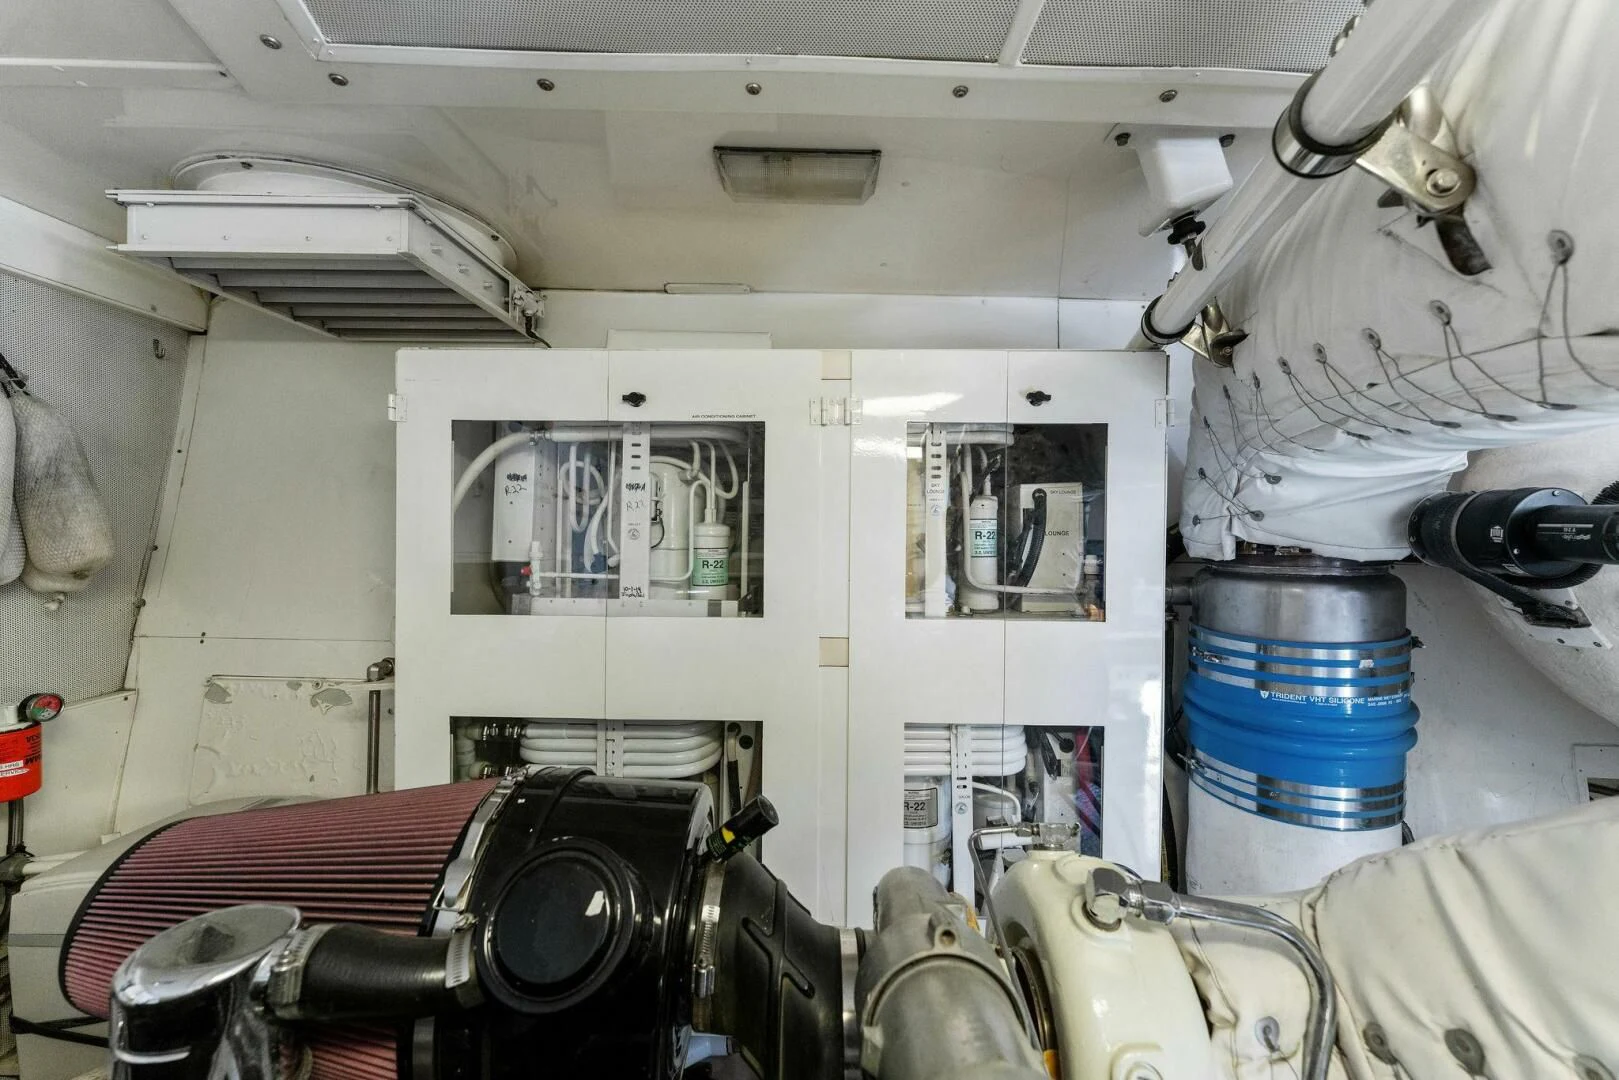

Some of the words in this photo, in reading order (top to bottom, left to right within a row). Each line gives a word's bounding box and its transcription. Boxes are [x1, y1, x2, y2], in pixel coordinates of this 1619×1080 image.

[975, 530, 996, 540] R-22
[702, 559, 724, 569] R-22
[1271, 691, 1307, 702] TRIDENT
[1309, 695, 1327, 703] VHT
[1328, 696, 1365, 704] SILICONE
[904, 801, 926, 811] R-22
